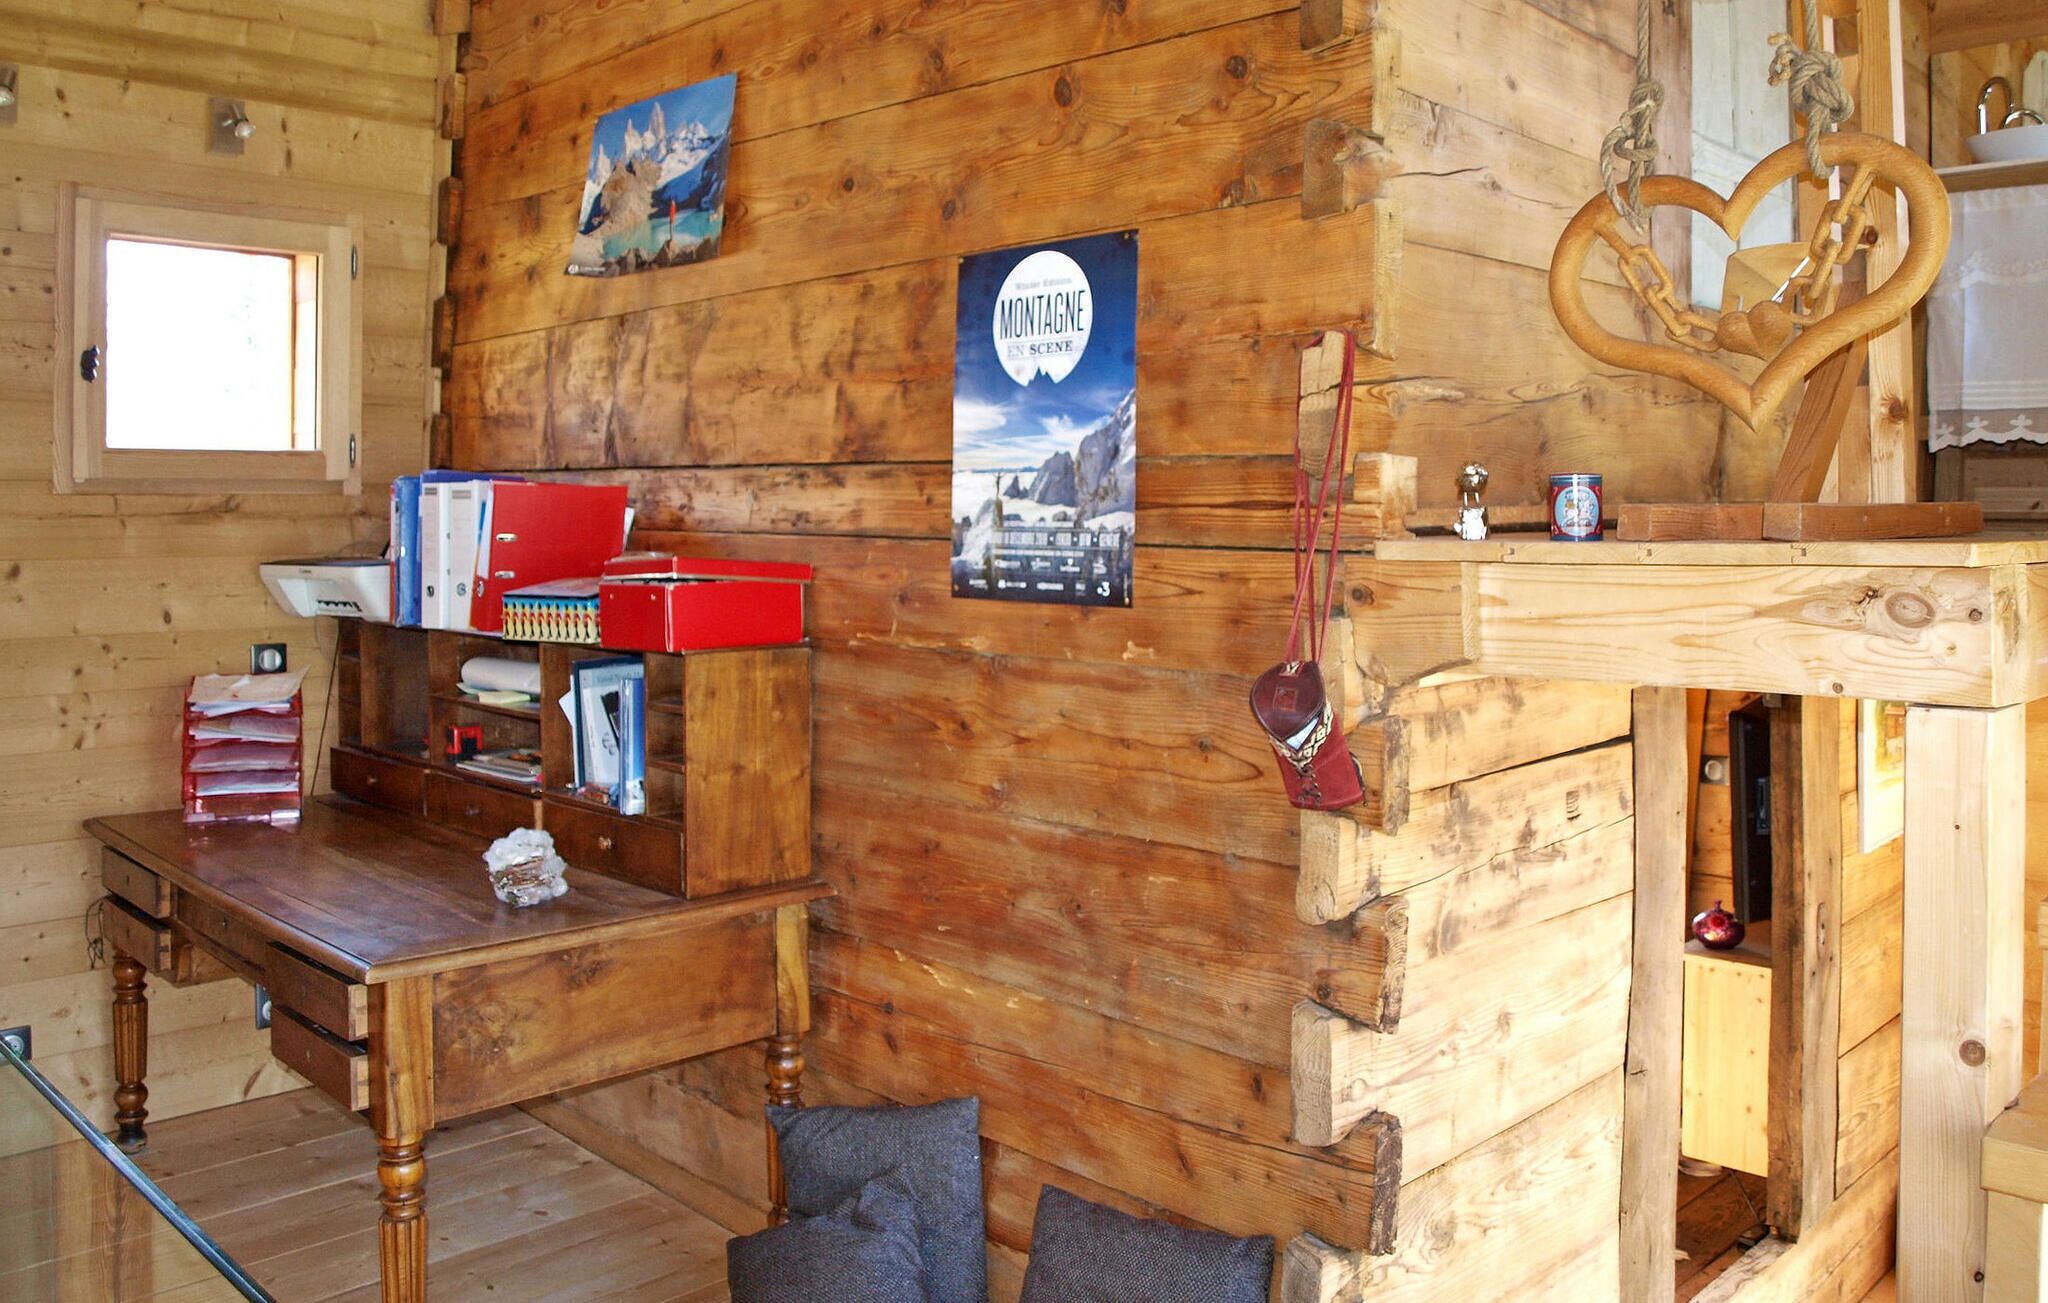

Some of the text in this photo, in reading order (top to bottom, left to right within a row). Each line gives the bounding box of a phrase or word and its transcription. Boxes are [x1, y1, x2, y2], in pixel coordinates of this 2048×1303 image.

[1000, 290, 1086, 339] MONTAGNE
[1008, 340, 1073, 358] EN SCENE
